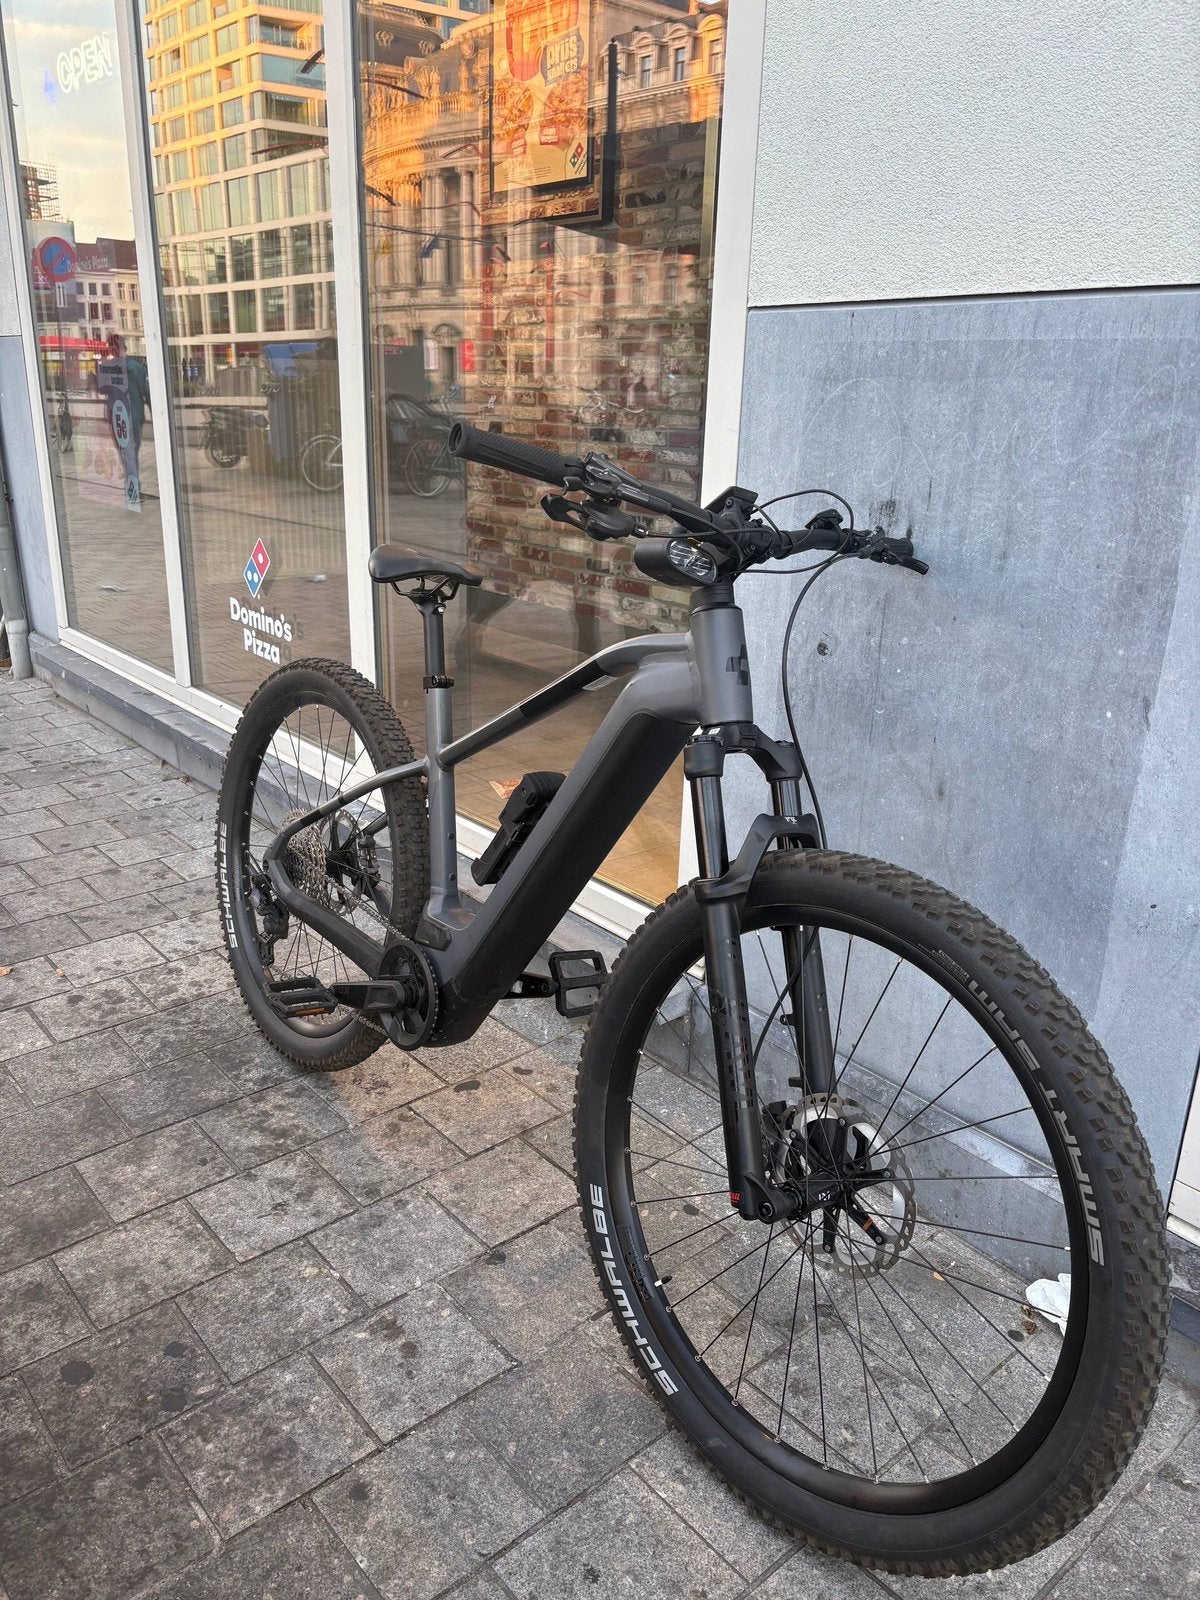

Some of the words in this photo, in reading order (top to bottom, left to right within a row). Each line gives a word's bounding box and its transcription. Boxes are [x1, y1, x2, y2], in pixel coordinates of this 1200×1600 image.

[57, 31, 113, 93] OPEN
[229, 596, 293, 642] Domino's
[243, 628, 280, 664] Pizza
[219, 821, 239, 949] SCHWALBE
[589, 1183, 679, 1397] SCHWALBE
